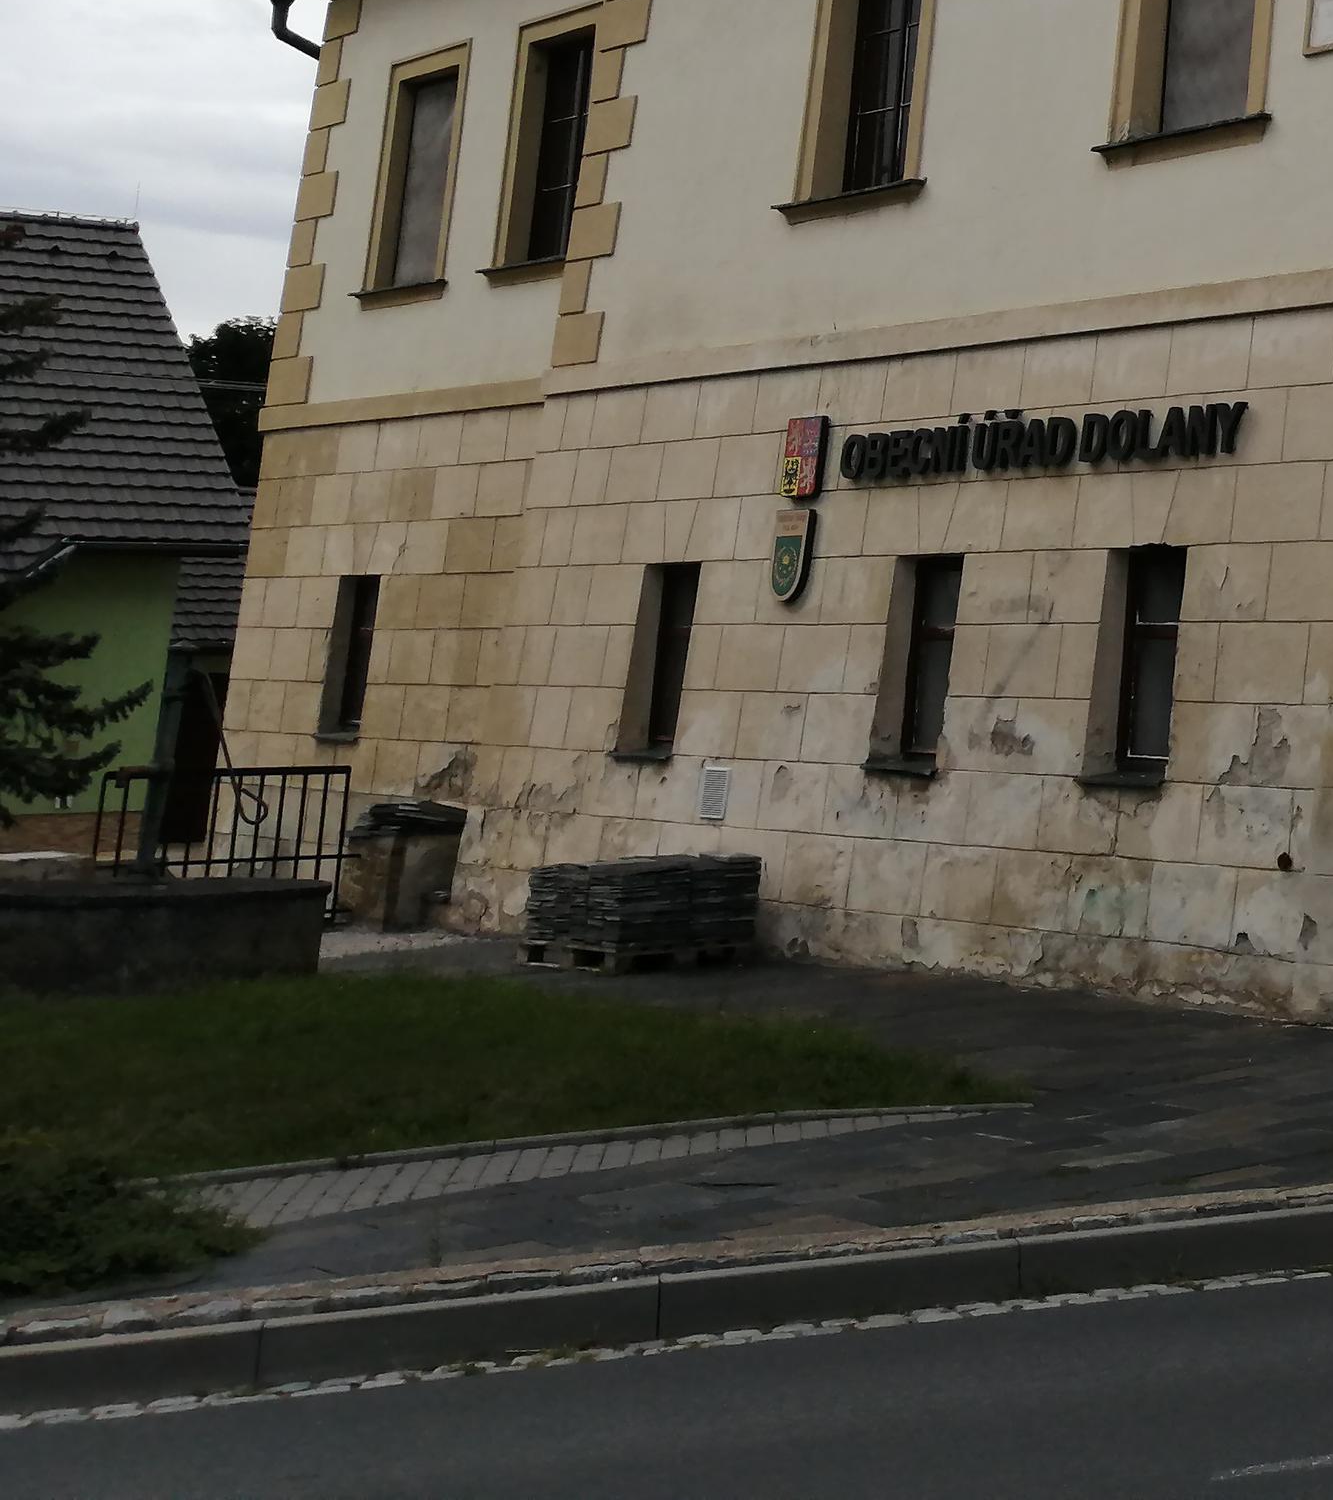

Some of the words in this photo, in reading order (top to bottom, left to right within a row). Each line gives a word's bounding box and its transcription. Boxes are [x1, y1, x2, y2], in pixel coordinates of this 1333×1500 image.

[840, 413, 972, 481] OBECNÍ
[971, 409, 1078, 472] ÚŘAD
[1078, 401, 1249, 463] DOLANY
